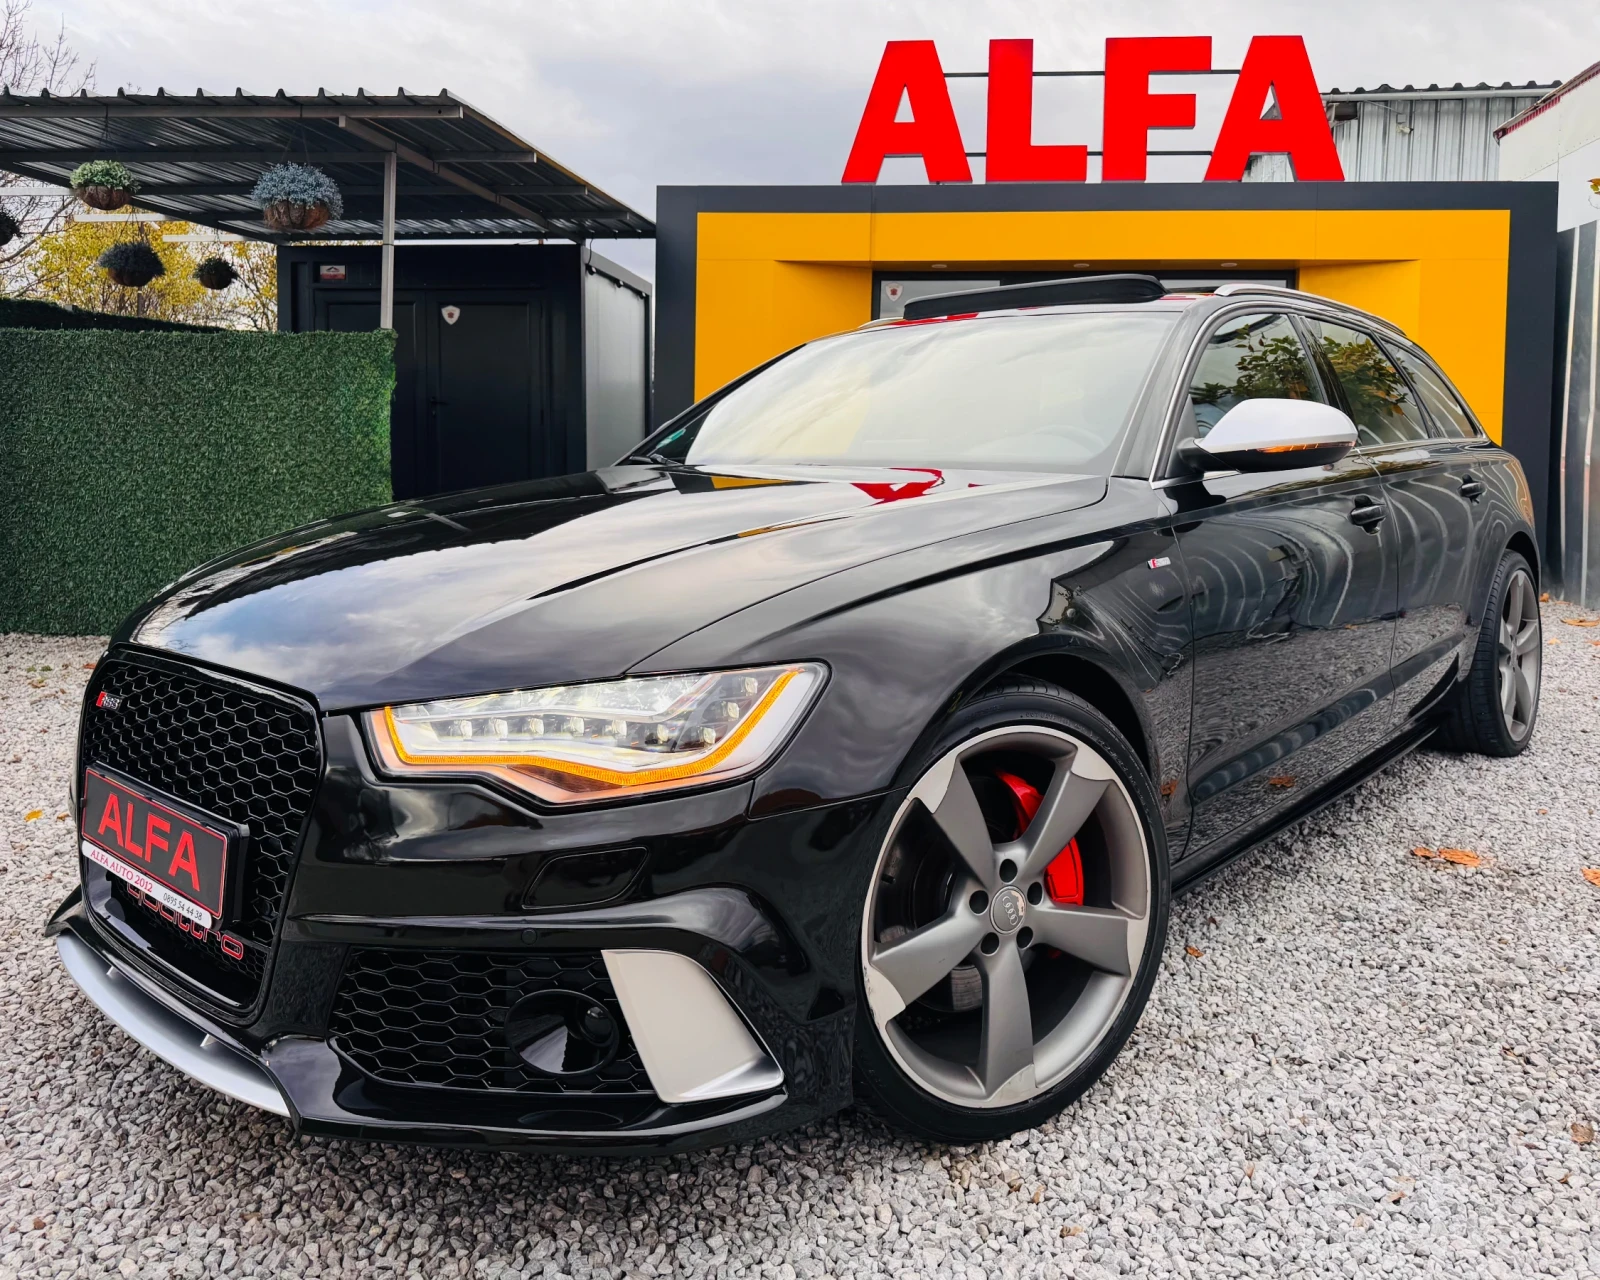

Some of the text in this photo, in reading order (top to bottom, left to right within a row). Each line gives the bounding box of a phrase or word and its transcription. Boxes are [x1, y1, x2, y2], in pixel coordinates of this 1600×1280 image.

[841, 35, 1345, 183] ALFA
[90, 849, 153, 893] ALFA AUTO 2012
[98, 793, 200, 892] ALFA
[163, 892, 203, 921] 0895 54 44 38
